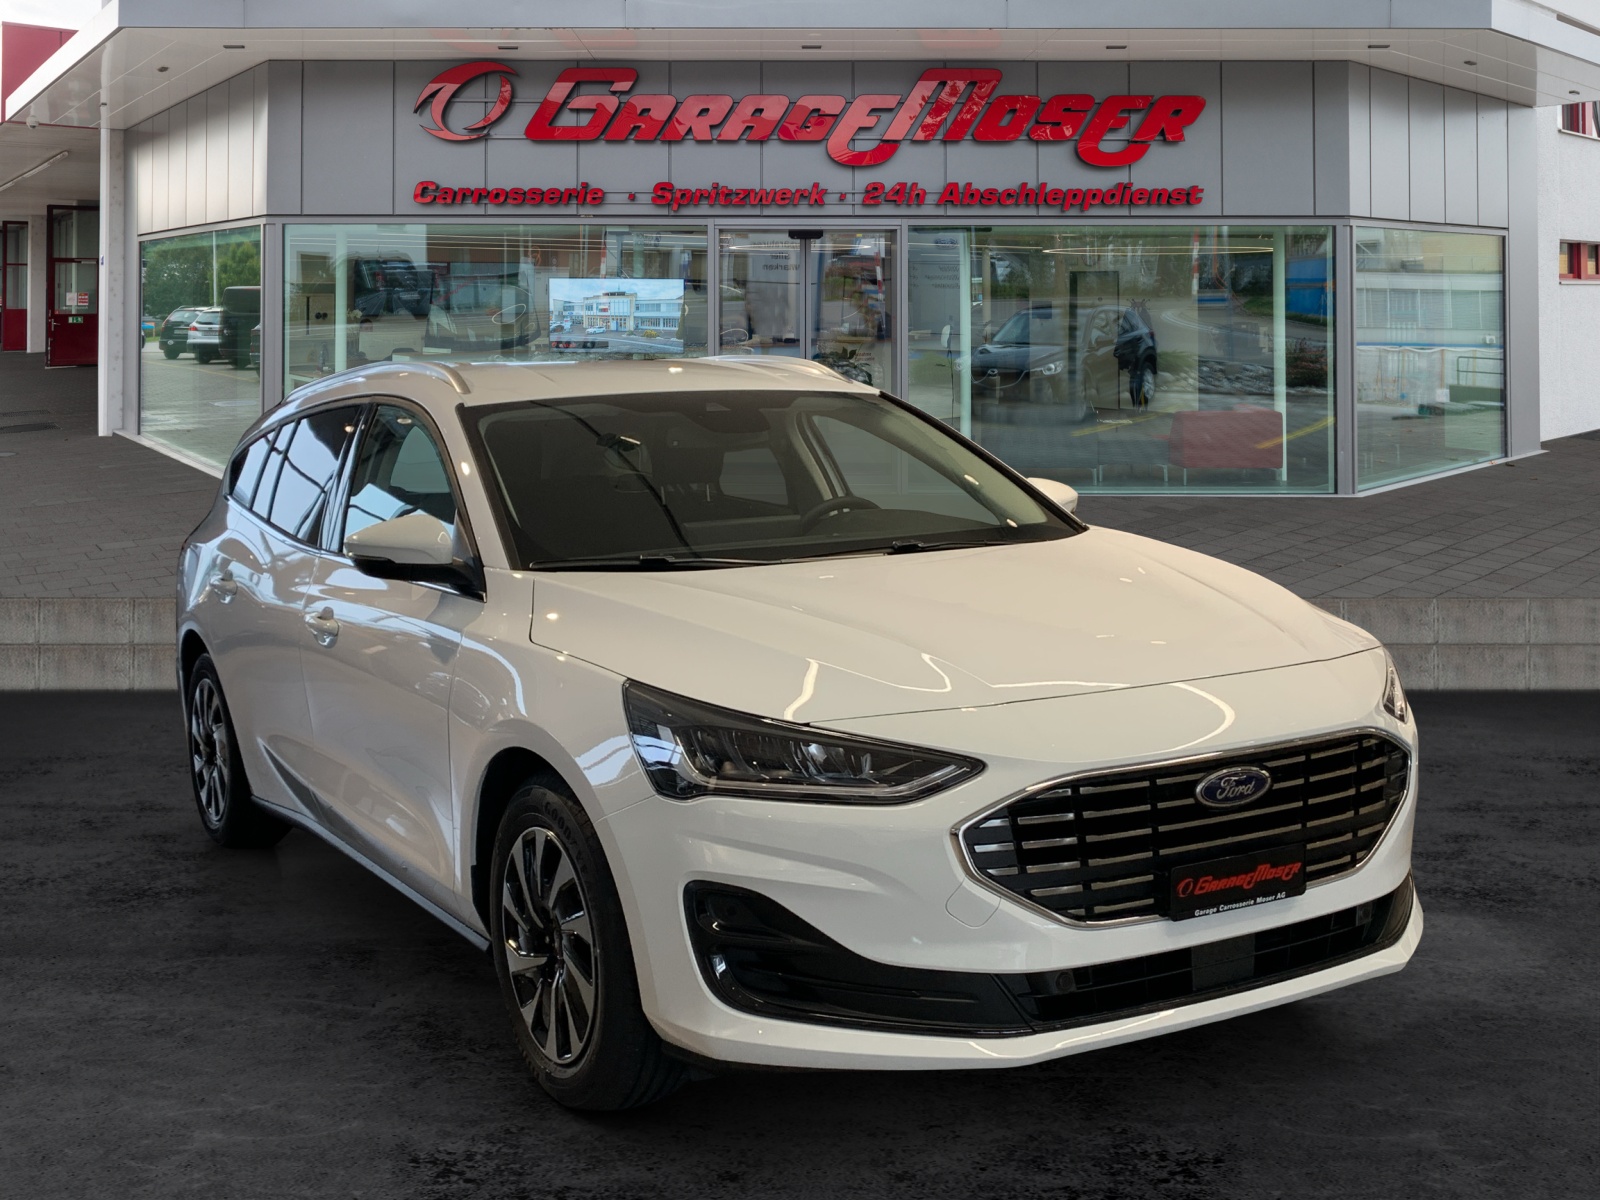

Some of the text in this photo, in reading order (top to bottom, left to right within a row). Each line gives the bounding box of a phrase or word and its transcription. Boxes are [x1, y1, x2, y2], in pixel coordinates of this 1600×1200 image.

[413, 181, 1204, 212] Carrosserie Spritzwerk 24h Abschleppdienst
[1216, 775, 1256, 799] Ford
[1194, 891, 1286, 916] Garage Carrosserie Moser AG
